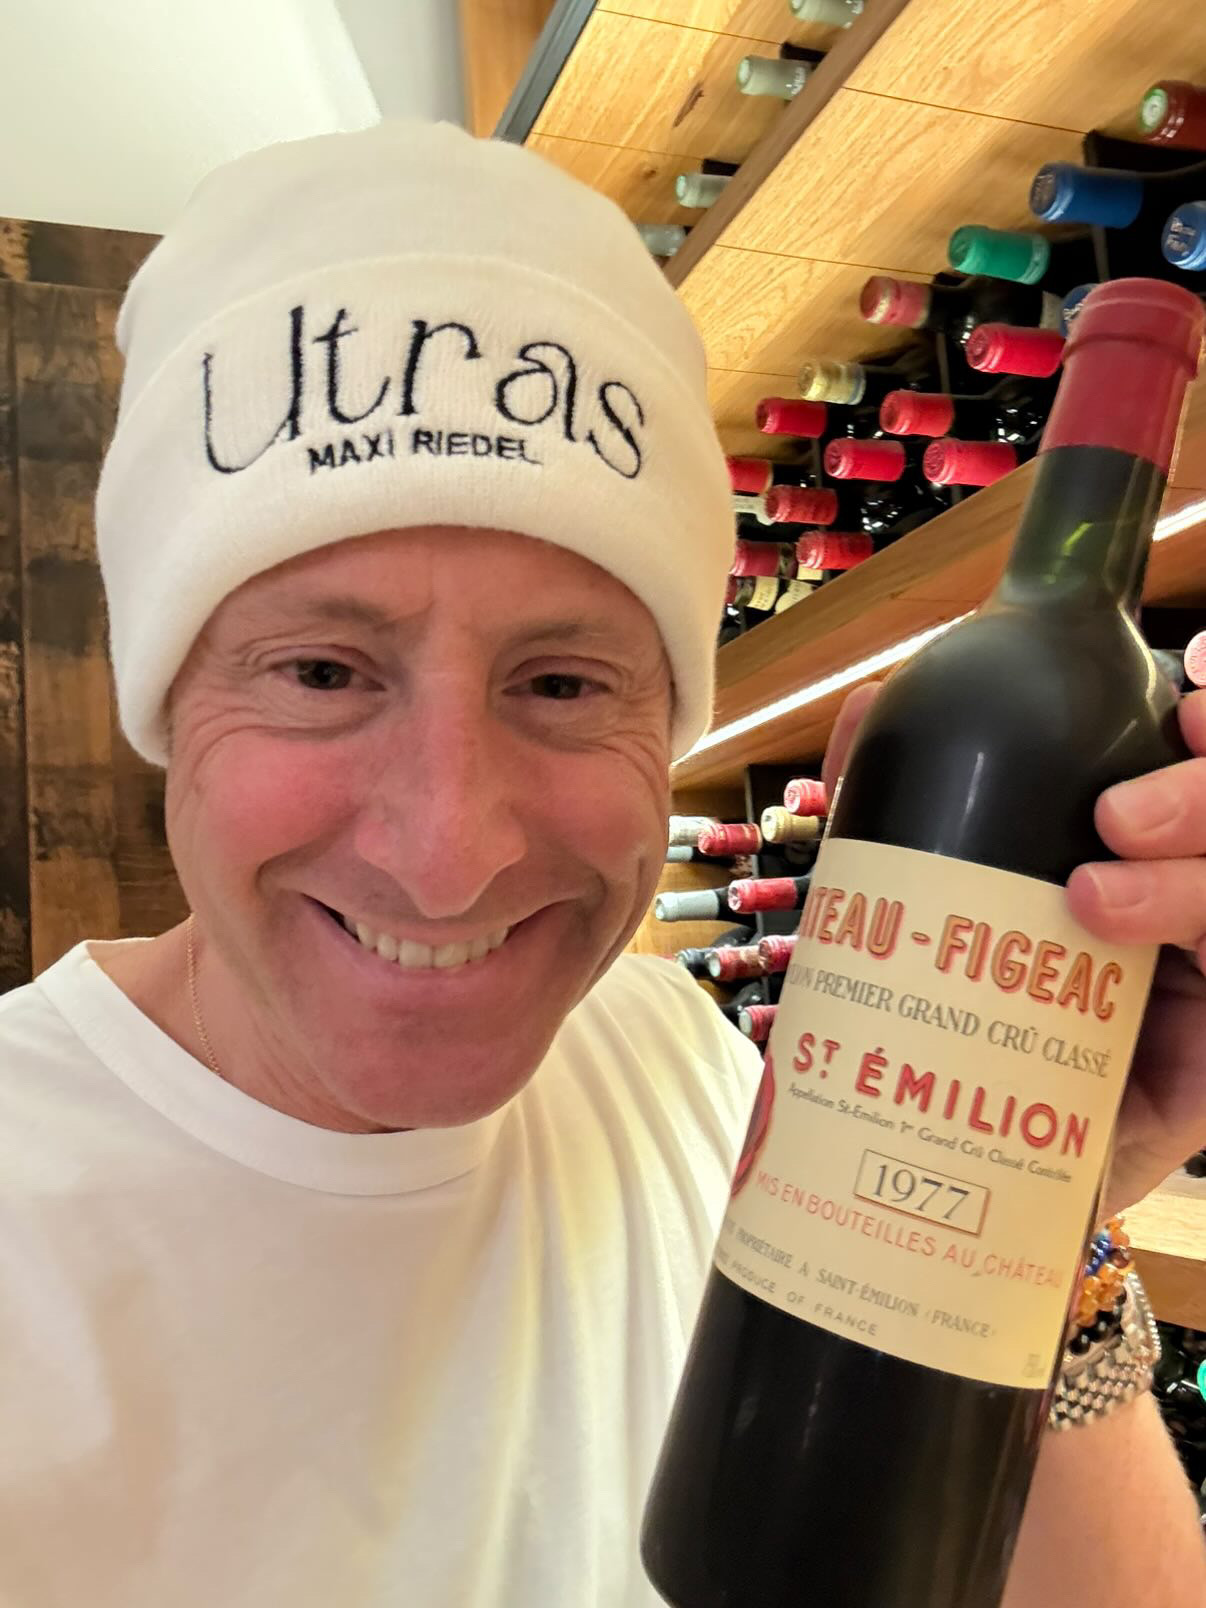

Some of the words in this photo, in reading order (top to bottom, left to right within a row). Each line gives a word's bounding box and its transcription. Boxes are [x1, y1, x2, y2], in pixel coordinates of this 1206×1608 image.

[308, 429, 395, 475] MAXI
[410, 428, 544, 466] RIEDEL
[934, 914, 1124, 1022] FIGEAC
[813, 969, 894, 1012] PREMIER
[898, 993, 980, 1037] GRAND
[1042, 1037, 1112, 1078] CLASSÉ
[855, 1047, 1090, 1158] ÉMILION
[917, 1127, 959, 1150] Grand
[755, 1169, 779, 1197] MIS
[780, 1180, 804, 1207] EN
[806, 1193, 937, 1258] BOUTEILLES
[943, 1244, 976, 1269] AU
[872, 1163, 971, 1222] 1977
[786, 1291, 806, 1305] OF
[814, 1303, 879, 1337] FRANCE
